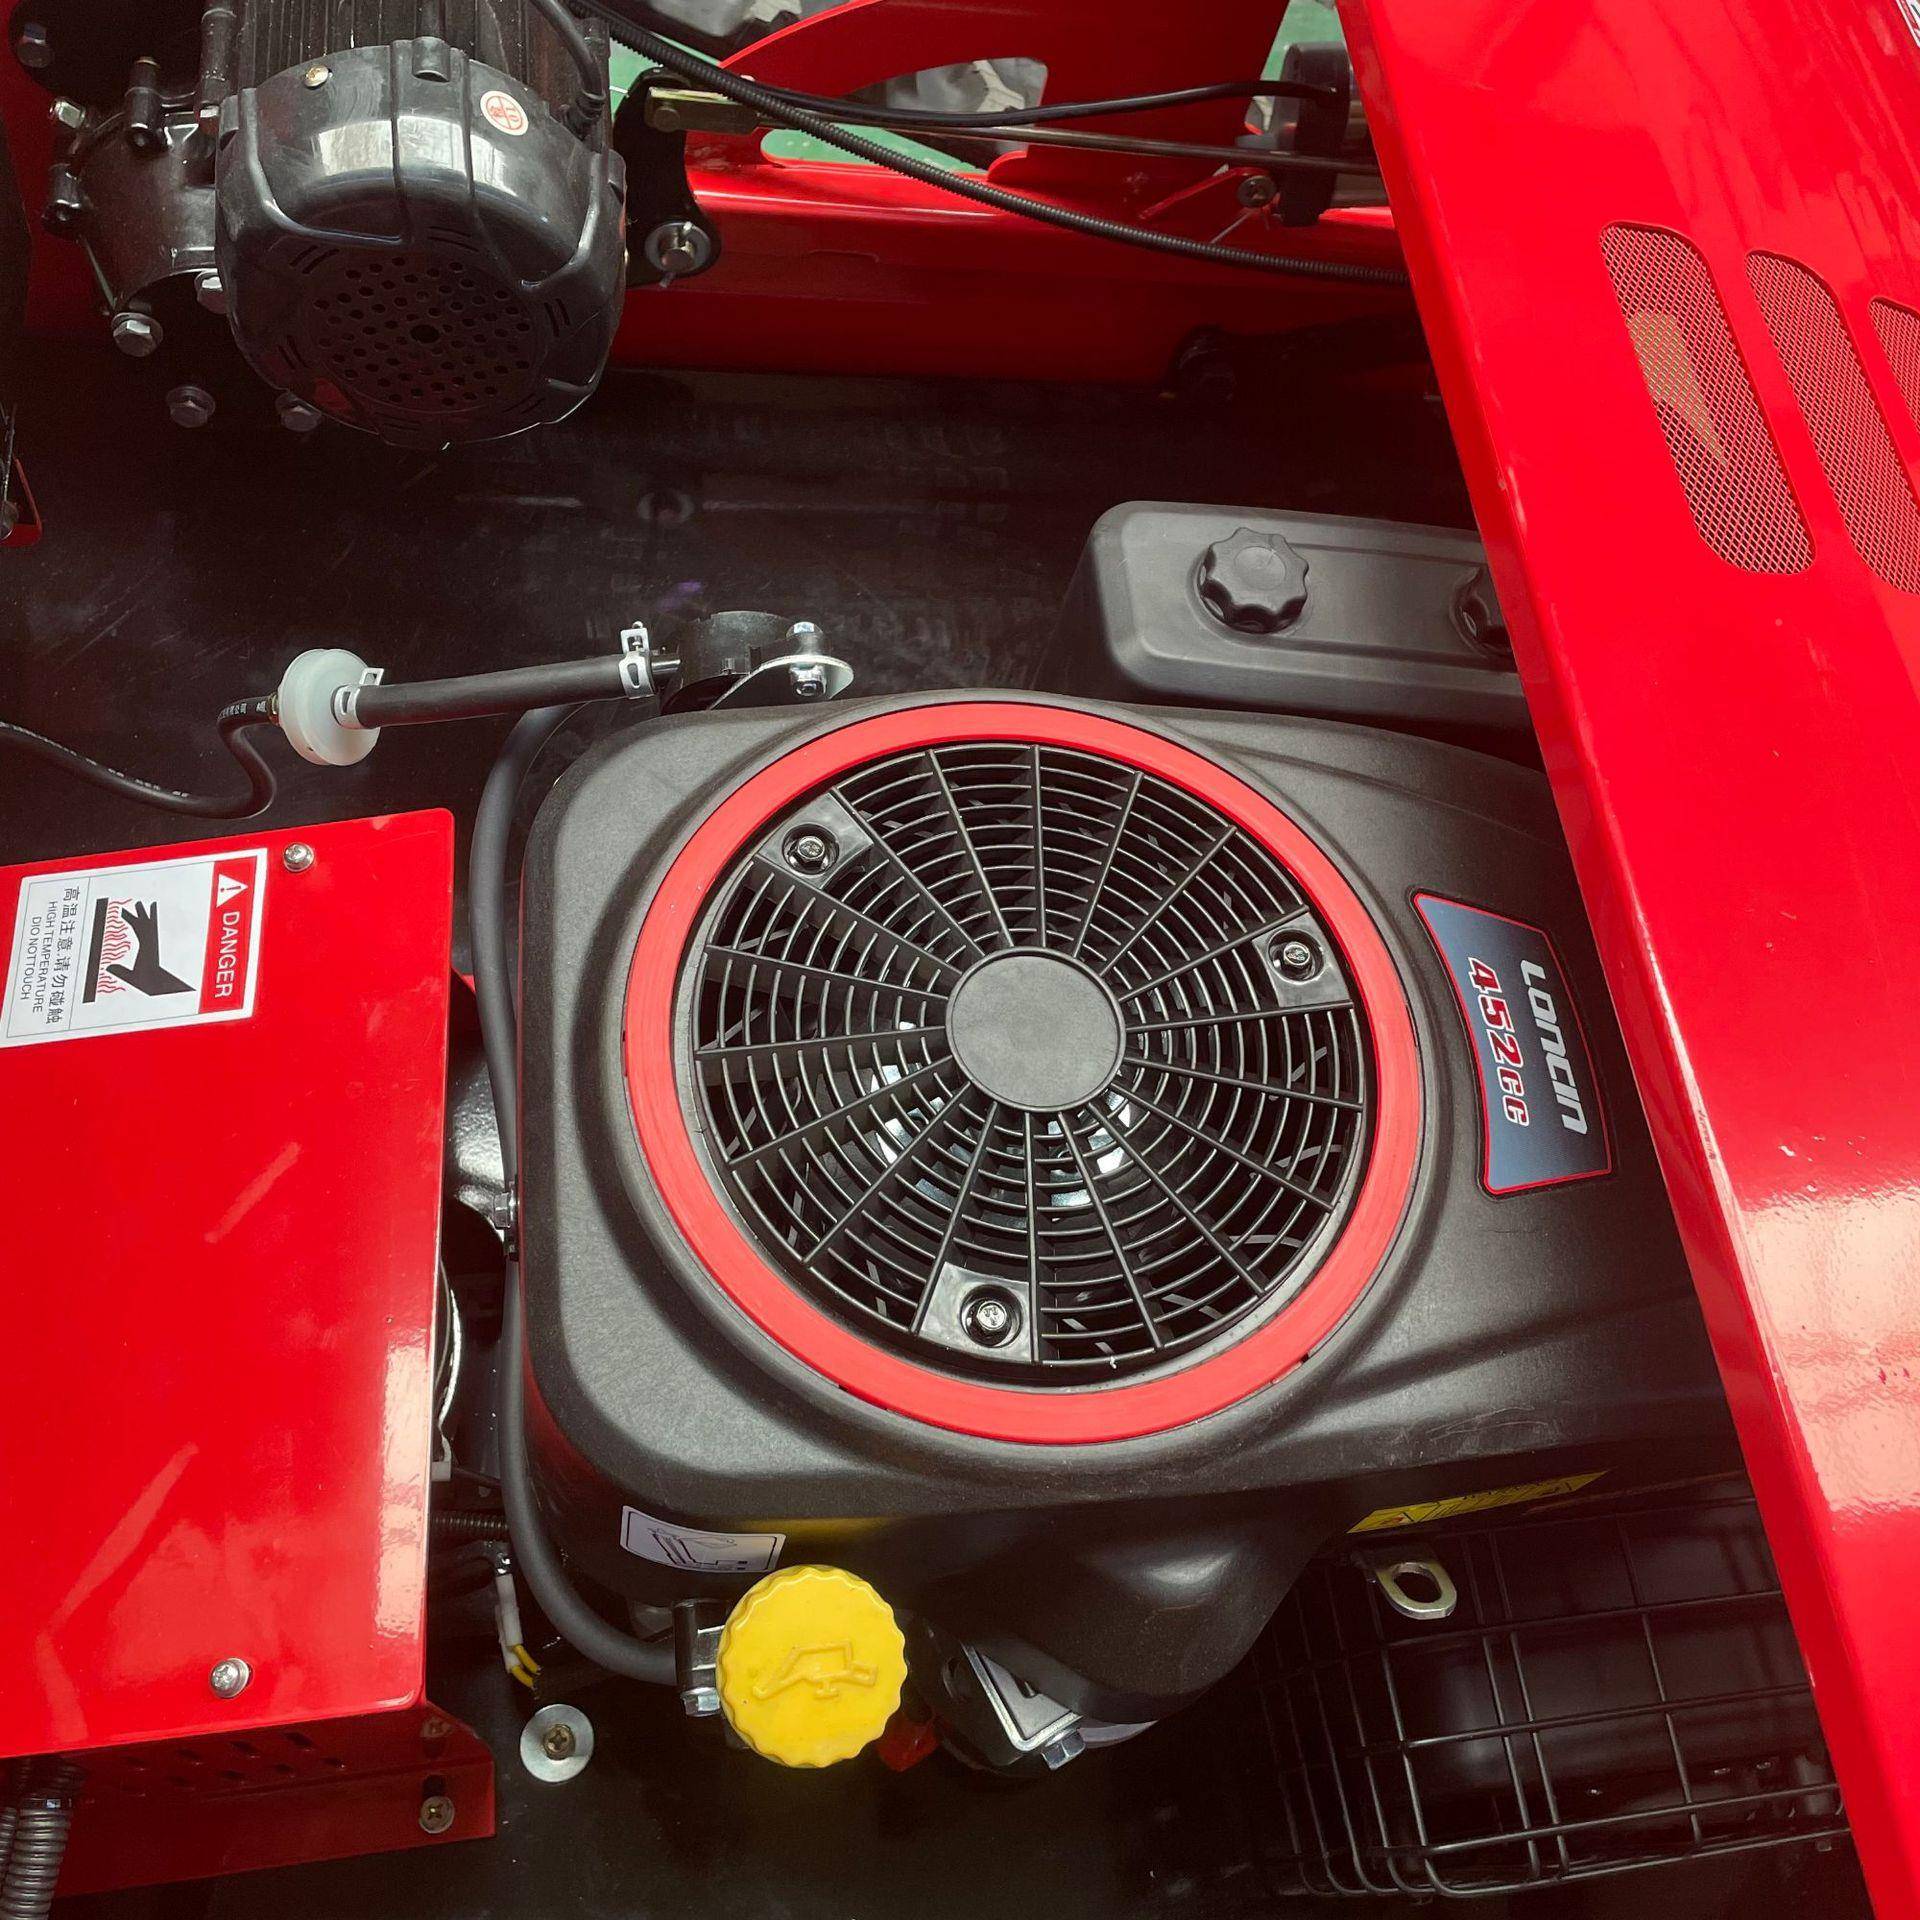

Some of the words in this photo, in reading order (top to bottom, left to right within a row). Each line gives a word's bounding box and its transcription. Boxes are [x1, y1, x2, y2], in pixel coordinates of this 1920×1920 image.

[46, 901, 58, 928] HIGH
[215, 911, 240, 998] DANGER
[33, 930, 54, 1013] TEMPERATURE
